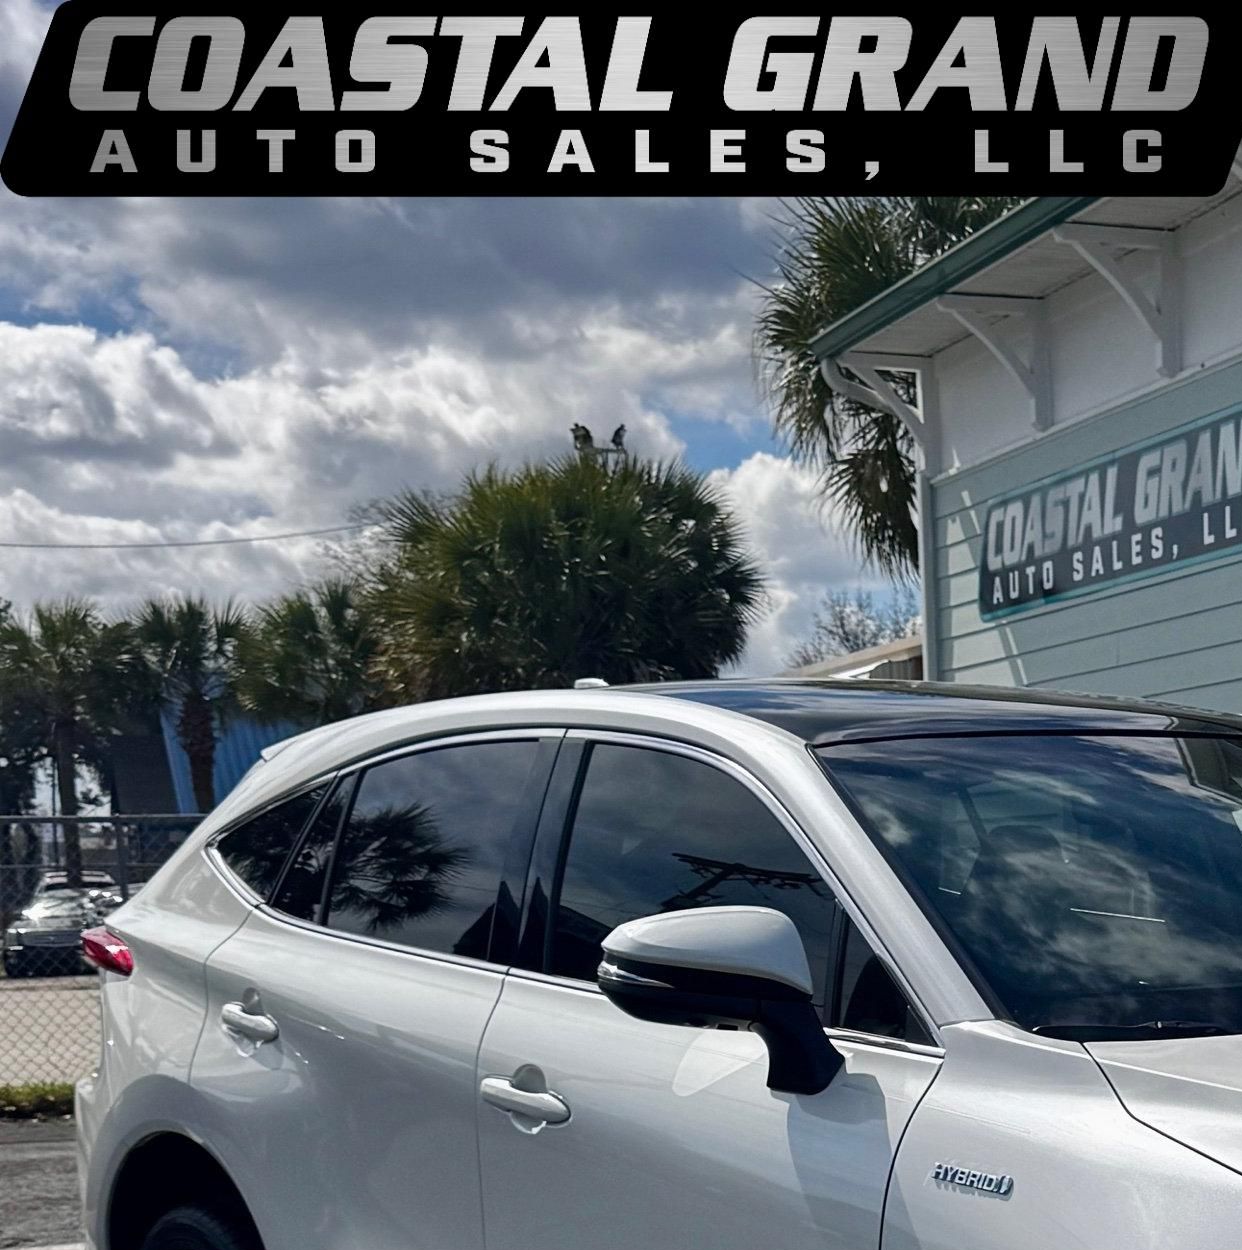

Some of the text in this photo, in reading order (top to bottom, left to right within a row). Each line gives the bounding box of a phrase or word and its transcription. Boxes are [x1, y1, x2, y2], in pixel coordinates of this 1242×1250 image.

[988, 463, 1123, 571] COASTAL
[992, 560, 1055, 605] AUTO
[1072, 526, 1179, 582] SALES,
[932, 1162, 997, 1192] HYBRID
